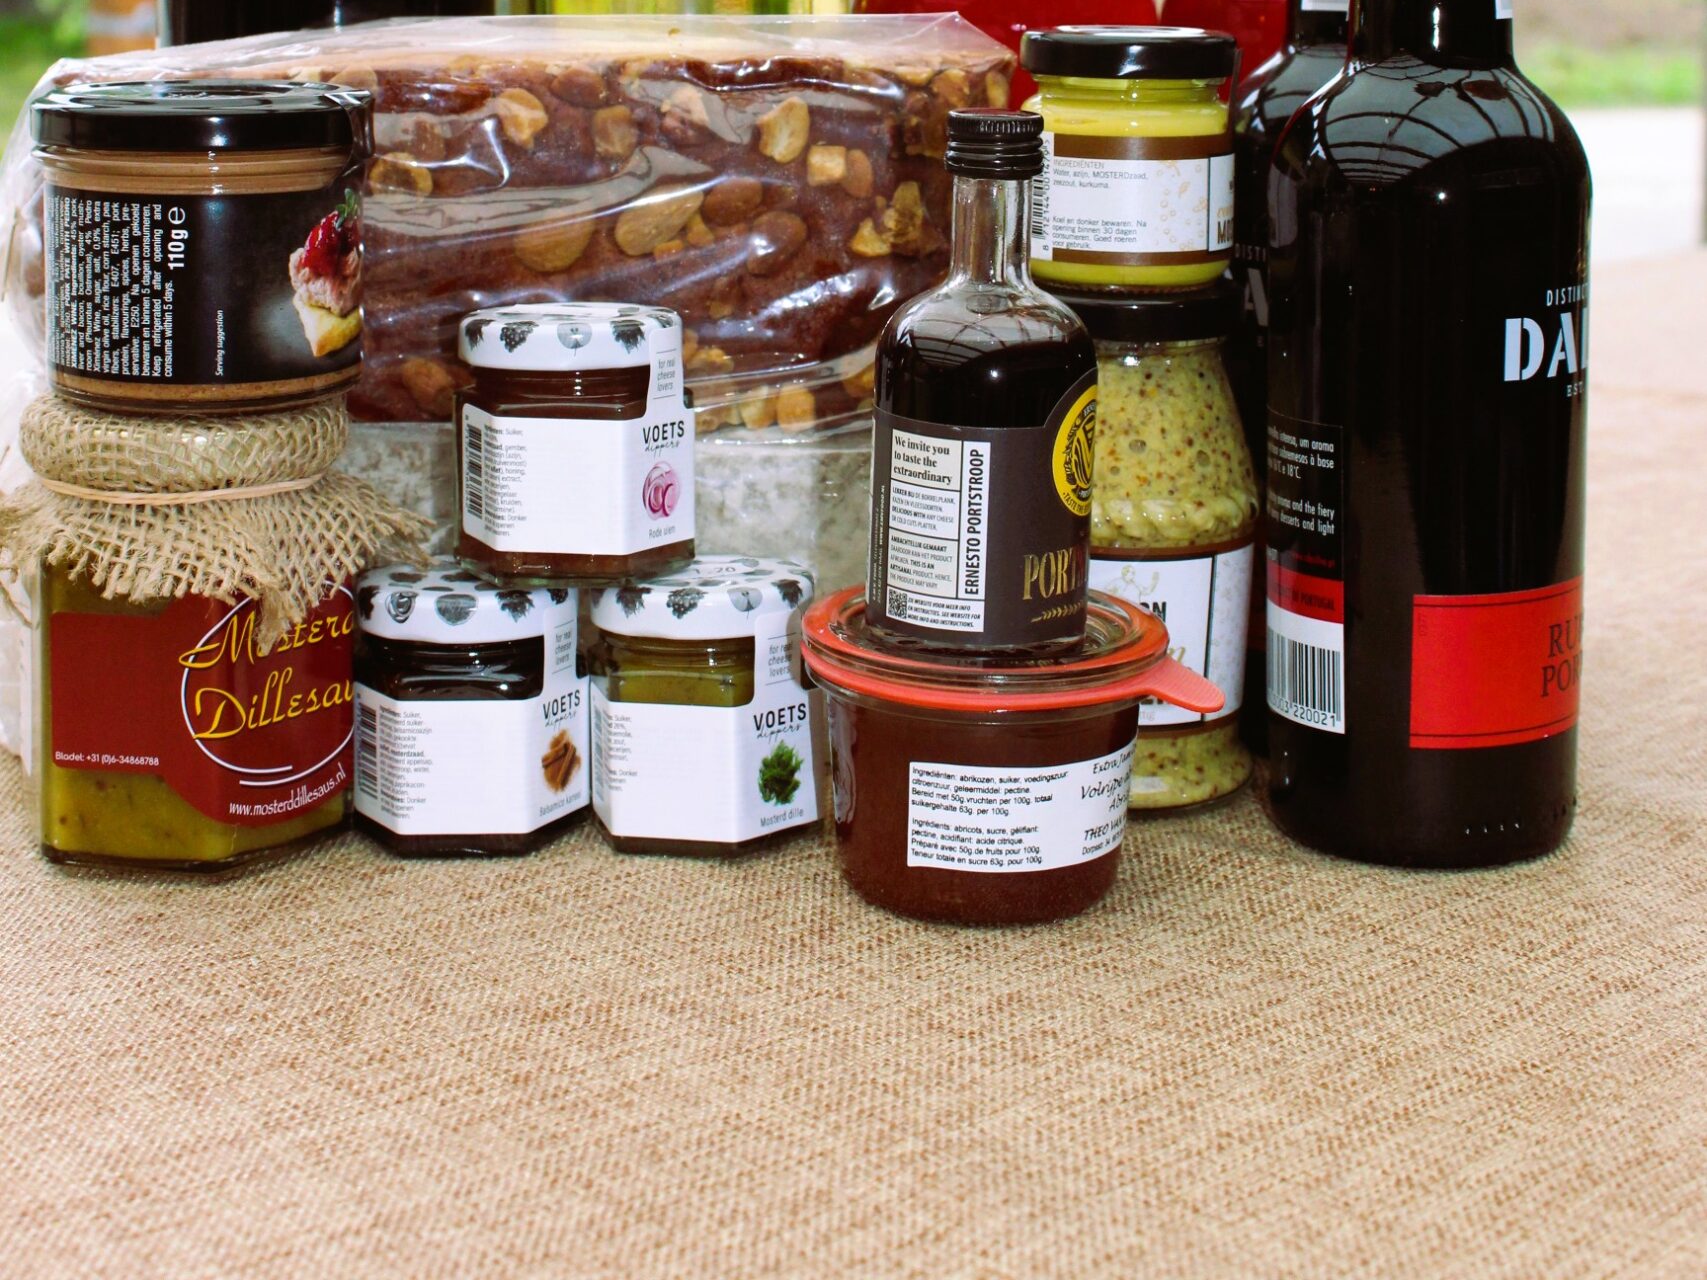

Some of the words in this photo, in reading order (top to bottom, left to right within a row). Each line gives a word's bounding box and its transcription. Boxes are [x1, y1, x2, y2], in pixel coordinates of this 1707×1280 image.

[103, 202, 111, 217] pea
[112, 203, 120, 220] pork
[152, 204, 161, 220] and
[132, 204, 141, 236] gekoeld
[86, 231, 93, 245] 4%
[121, 226, 130, 251] herbs,
[153, 229, 162, 262] opening
[132, 245, 141, 275] openen
[121, 257, 130, 286] spices,
[142, 261, 151, 285] dagen
[152, 271, 161, 290] after
[131, 284, 139, 295] Na
[163, 280, 174, 302] days.
[102, 296, 110, 311] rice
[142, 297, 150, 324] binnen
[112, 296, 120, 339] stabilizers:
[131, 304, 139, 328] E250.
[152, 299, 162, 347] refrigerated
[163, 312, 172, 337] within
[102, 328, 110, 347] olive
[144, 328, 150, 337] en
[216, 310, 225, 348] suggestion
[102, 351, 111, 373] virgin
[121, 344, 130, 375] protein,
[131, 337, 139, 376] servative:
[142, 341, 150, 376] bewaren
[152, 356, 162, 376] Keep
[165, 339, 173, 377] consume
[215, 350, 225, 376] Serving
[643, 420, 684, 444] VOETS
[895, 436, 905, 447] We
[908, 438, 930, 452] invite
[933, 446, 950, 455] you
[1312, 440, 1334, 452] aroma
[894, 451, 901, 460] to
[903, 453, 921, 465] taste
[923, 456, 937, 467] the
[1317, 454, 1334, 469] base
[894, 465, 952, 485] extraordinary
[967, 449, 984, 534] PORTSTROOP
[1292, 500, 1302, 512] and
[1305, 501, 1315, 515] the
[1318, 503, 1335, 520] fiery
[1303, 518, 1315, 531] and
[1318, 519, 1335, 536] light
[965, 538, 980, 595] ERNESTO
[769, 644, 778, 654] for
[768, 654, 792, 666] cheese
[543, 689, 580, 719] VOETS
[754, 703, 806, 731] VOETS
[1293, 704, 1336, 727] 220021
[55, 751, 84, 761] Bladel:
[87, 754, 100, 762] +31
[229, 761, 346, 816] www.mosterddillesaus.nl
[959, 775, 997, 784] abrikozen,
[999, 775, 1021, 784] suiker,
[911, 787, 934, 798] Bereid
[936, 792, 949, 801] met
[967, 796, 997, 804] vruchten
[999, 798, 1011, 806] per
[1035, 794, 1053, 803] totaal
[760, 810, 786, 826] Mosterd
[788, 808, 803, 819] dille
[911, 798, 957, 813] suikergehalte
[976, 808, 989, 816] per
[911, 828, 938, 839] pectine,
[940, 833, 974, 844] acidifiant:
[976, 837, 995, 845] acide
[954, 825, 984, 835] abricots,
[986, 827, 1008, 835] sucre,
[1084, 823, 1109, 841] THEO
[911, 838, 938, 850] Préparé
[941, 844, 957, 852] avec
[974, 847, 984, 855] de
[911, 848, 934, 859] Teneur
[936, 853, 955, 862] totale
[1007, 858, 1023, 866] pour
